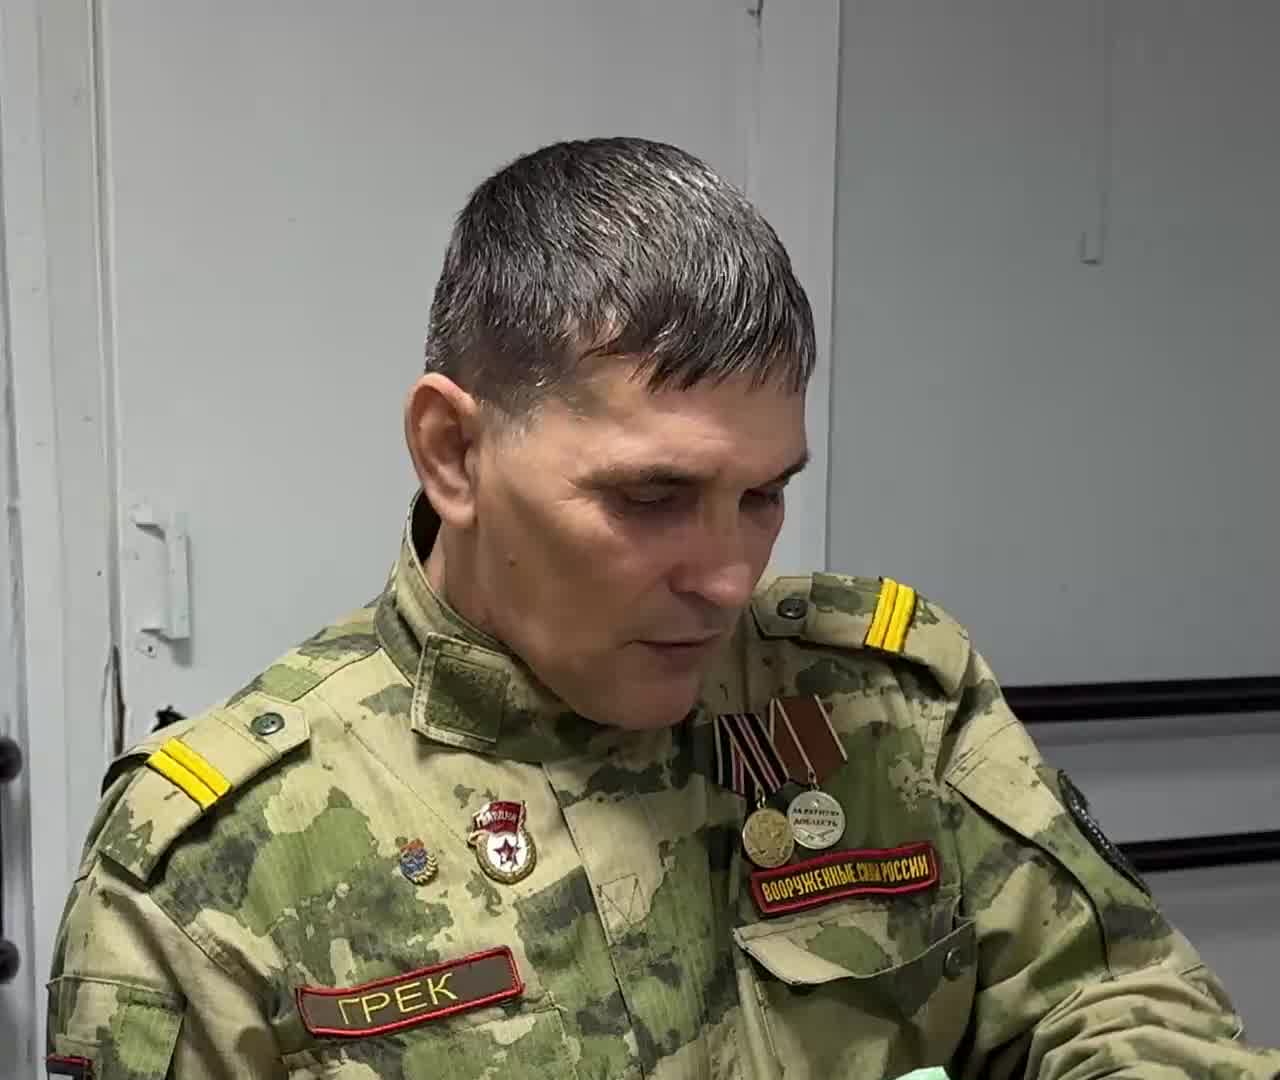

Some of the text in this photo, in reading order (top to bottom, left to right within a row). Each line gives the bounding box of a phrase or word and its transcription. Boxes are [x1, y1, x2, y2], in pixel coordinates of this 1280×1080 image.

[761, 863, 857, 903] ВООРУЖЕННЫЕ
[881, 855, 930, 883] РОССИИ
[337, 972, 459, 1025] ГРЕК
